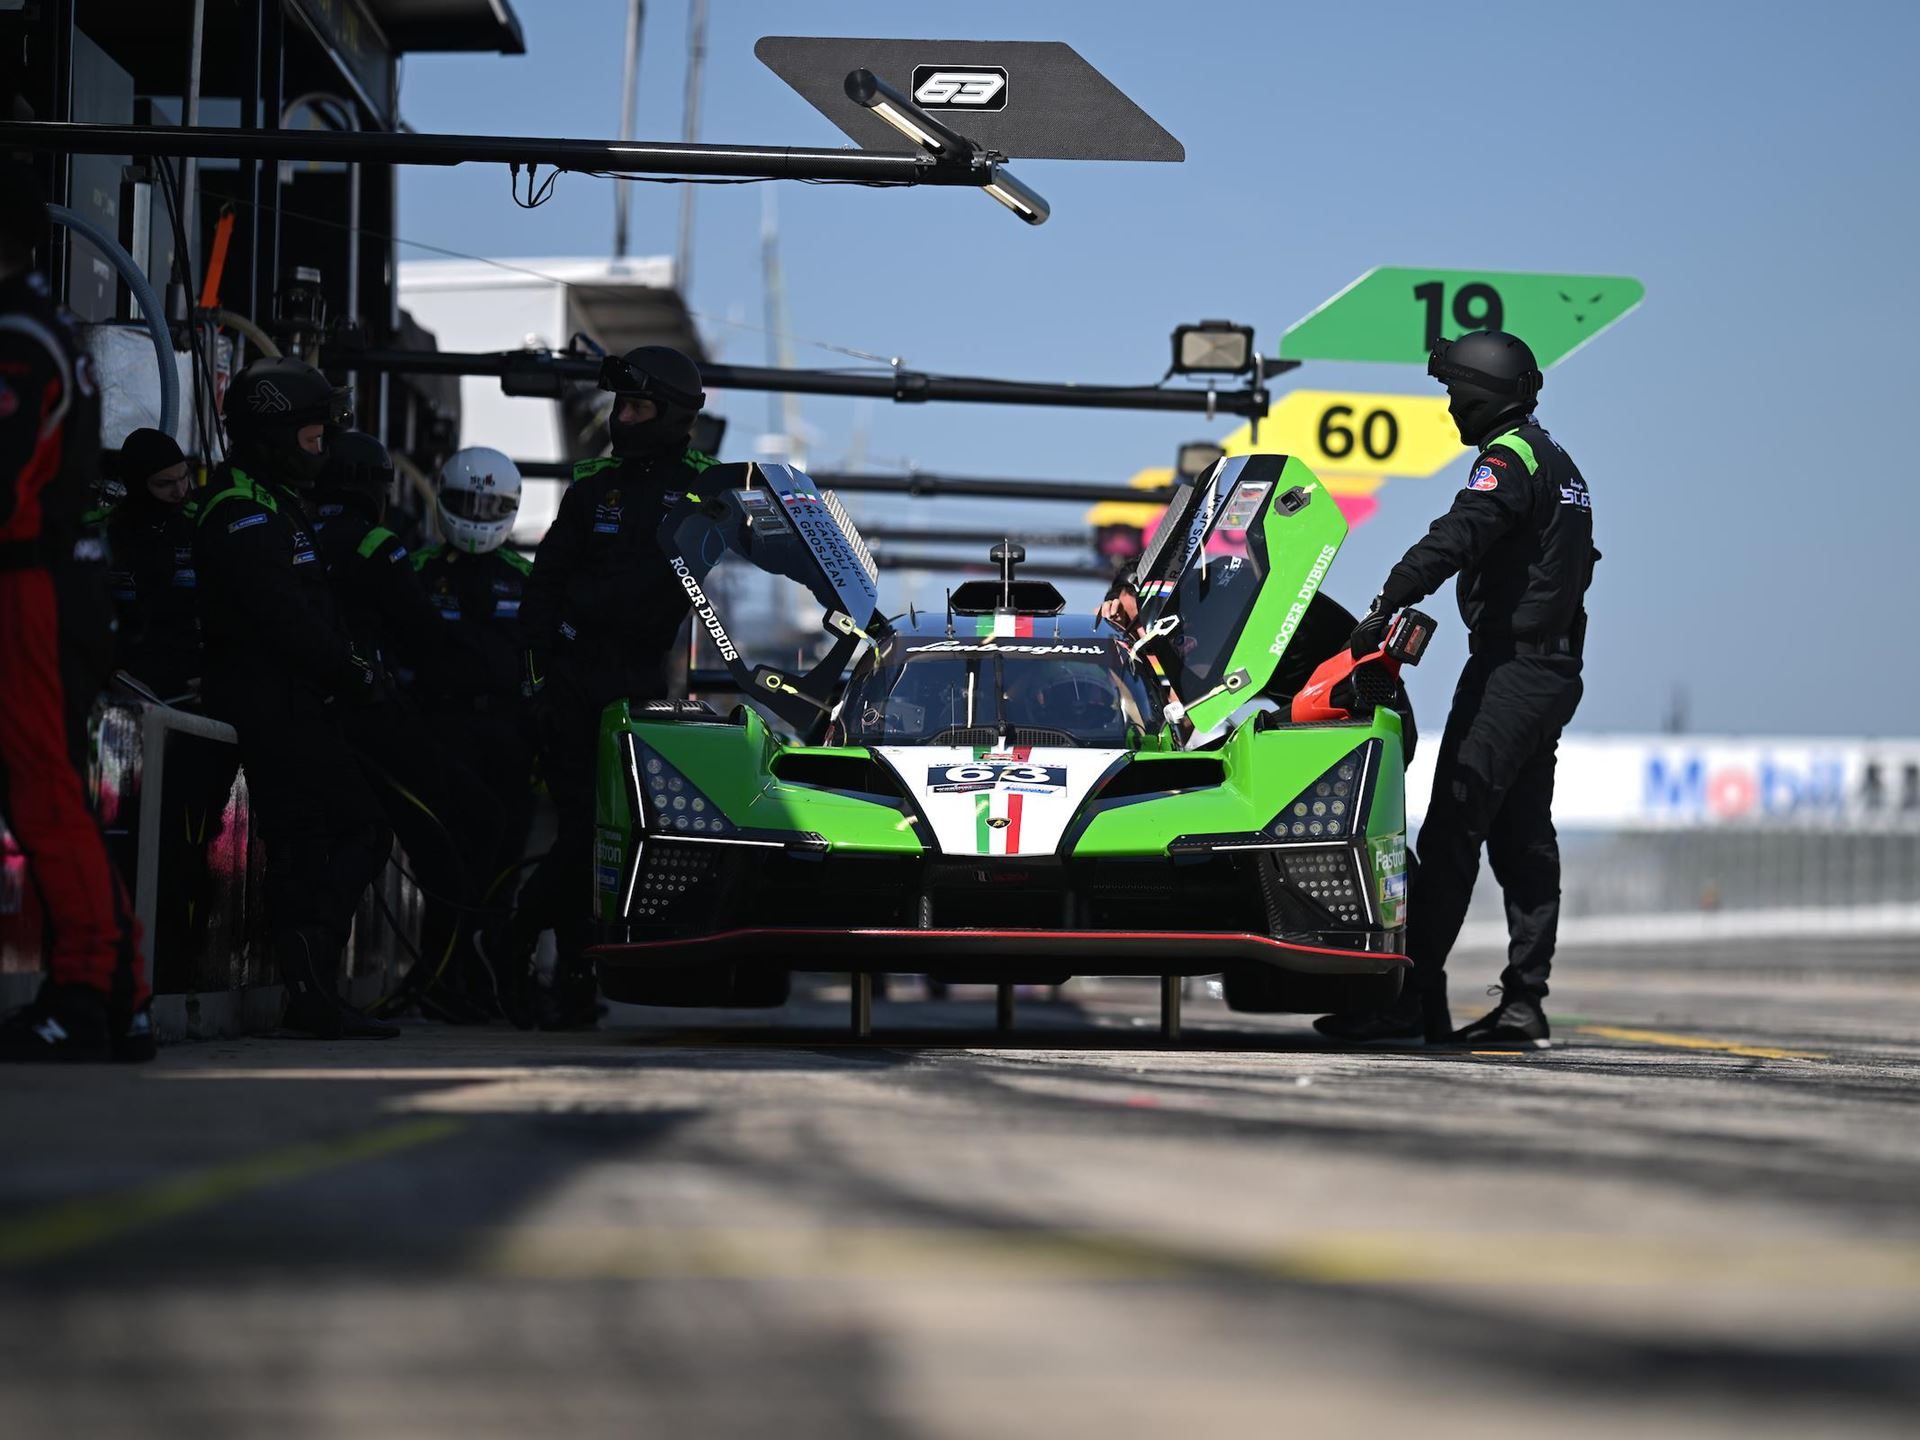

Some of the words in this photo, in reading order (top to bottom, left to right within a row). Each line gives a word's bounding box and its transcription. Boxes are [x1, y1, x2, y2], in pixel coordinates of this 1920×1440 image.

[914, 72, 1005, 104] 63
[1413, 281, 1505, 351] 19
[1318, 405, 1398, 460] 60
[790, 506, 802, 518] R.
[800, 521, 846, 588] GROSJEAN
[815, 521, 849, 570] CAIROLI
[670, 556, 707, 607] ROGER
[698, 604, 739, 661] DUBUIS
[1269, 602, 1306, 658] ROGER
[1299, 545, 1335, 604] DUBUIS
[906, 640, 1105, 655] Lamborghini
[945, 765, 1051, 783] 63
